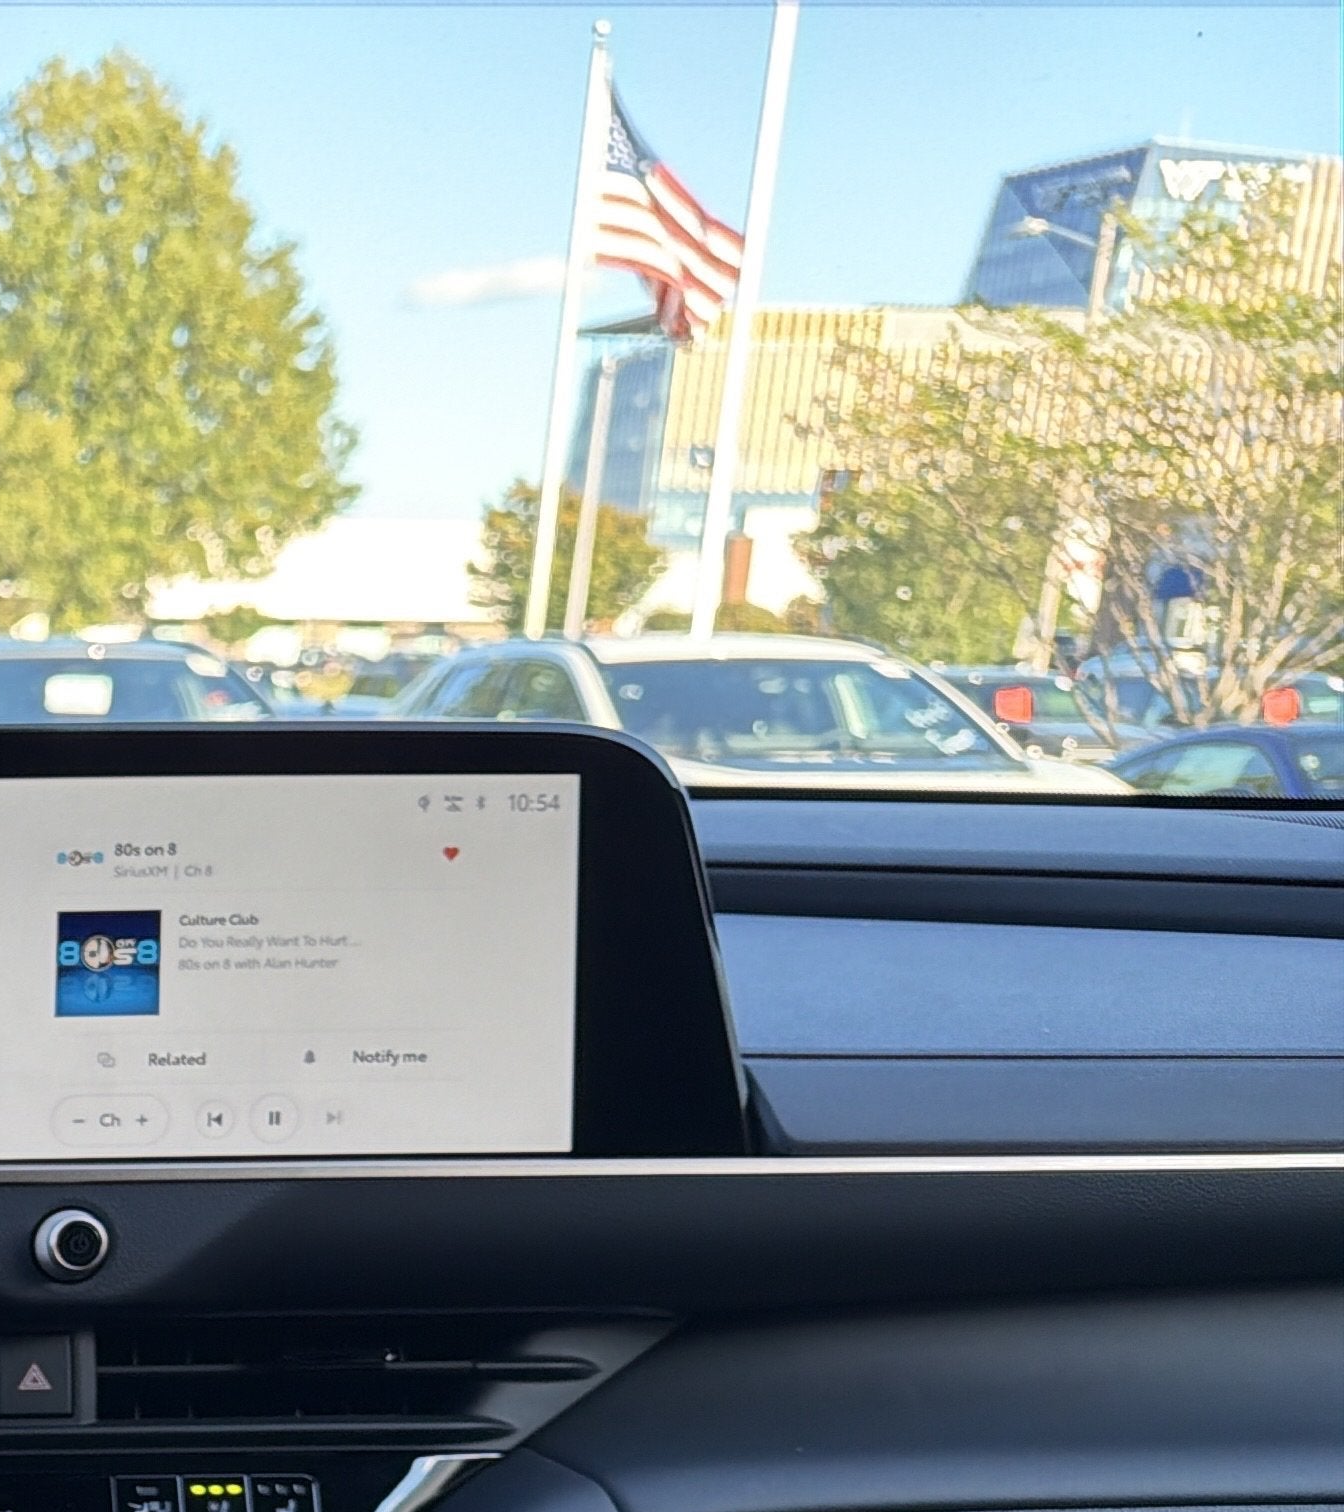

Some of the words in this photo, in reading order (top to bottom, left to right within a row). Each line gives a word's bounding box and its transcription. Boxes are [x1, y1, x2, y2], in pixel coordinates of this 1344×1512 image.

[508, 793, 561, 812] 10:54
[114, 843, 141, 857] 80s
[144, 846, 164, 857] on
[167, 842, 177, 857] 8
[113, 866, 168, 879] SiriusXM
[184, 865, 202, 878] Ch
[204, 865, 213, 877] 8
[179, 914, 226, 927] Culture
[229, 914, 259, 926] Club
[179, 936, 197, 949] Do
[200, 936, 224, 949] You
[226, 935, 263, 950] Really
[267, 935, 300, 948] Want
[303, 935, 318, 947] To
[178, 958, 202, 971] 80s
[204, 960, 220, 971] on
[234, 957, 261, 970] with
[263, 957, 292, 970] Alan
[295, 957, 338, 970] Hunter
[148, 1052, 206, 1067] Related
[352, 1049, 400, 1068] Notify
[402, 1053, 427, 1064] me
[99, 1113, 121, 1128] Ch
